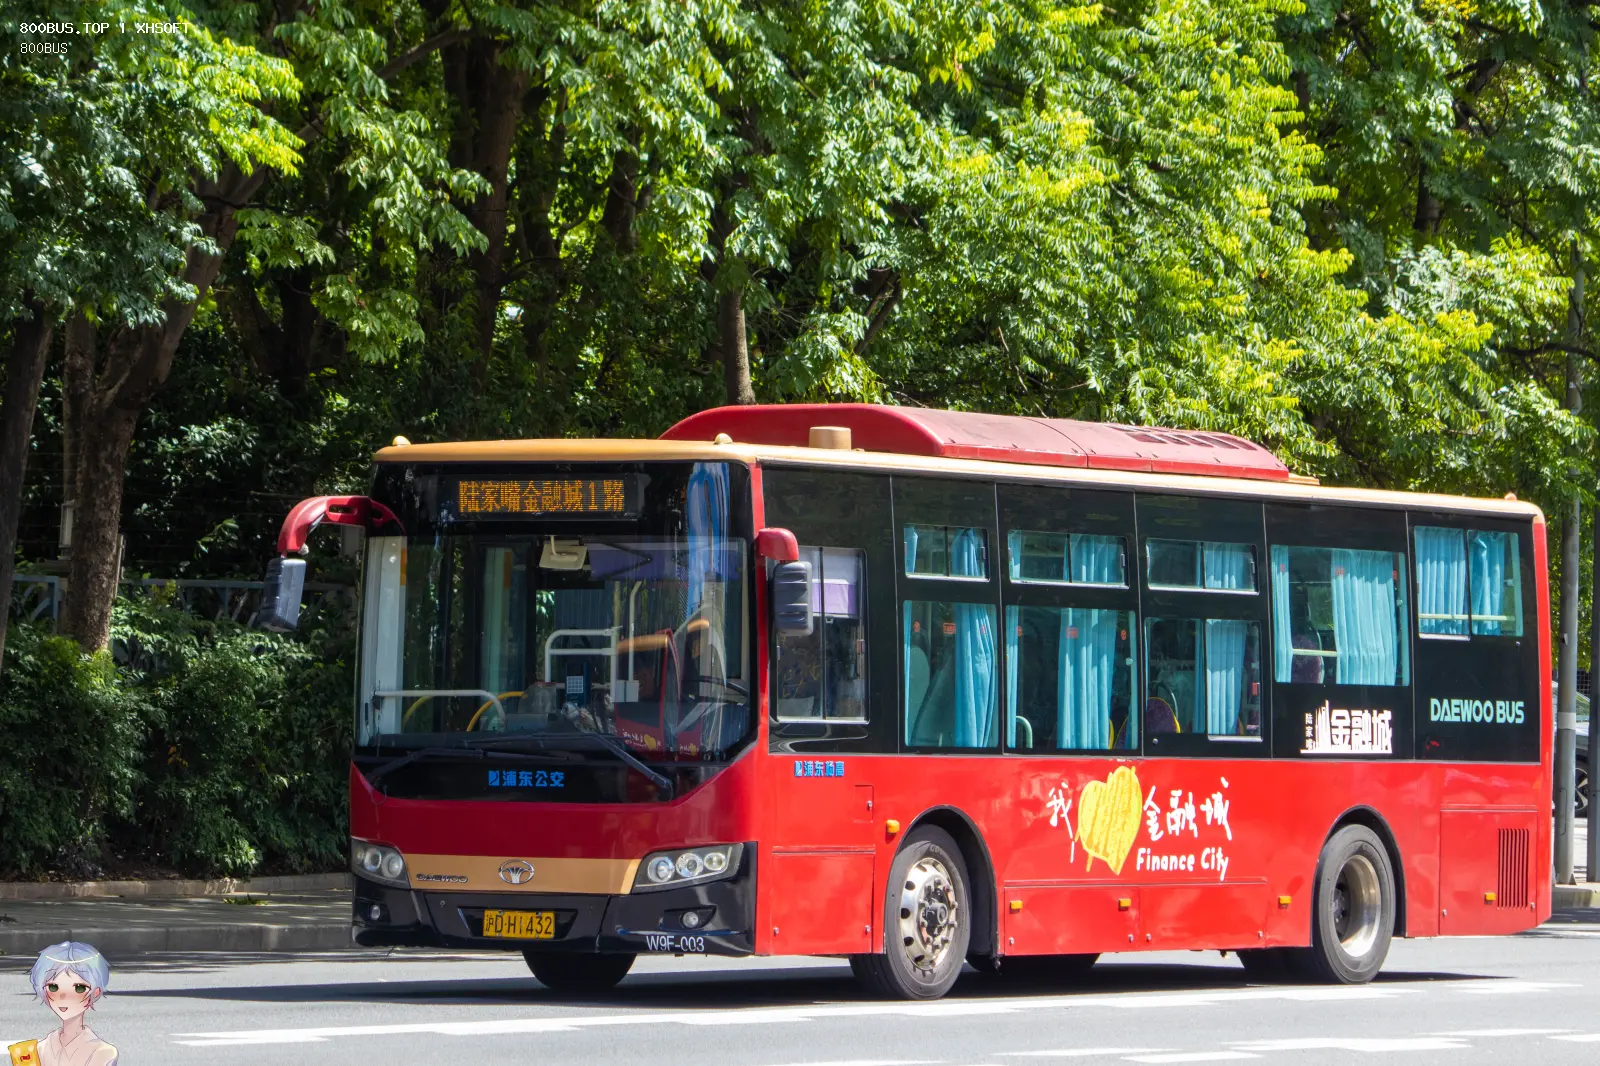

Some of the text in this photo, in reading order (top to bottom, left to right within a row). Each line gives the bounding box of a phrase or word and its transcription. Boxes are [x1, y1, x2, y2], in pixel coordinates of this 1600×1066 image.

[1430, 698, 1524, 724] DAEWOO BUS
[1330, 709, 1392, 751] 金融城
[503, 770, 565, 787] 浦东公交
[1046, 776, 1232, 863] 我 金融城
[1136, 847, 1229, 882] Finance City
[416, 873, 468, 883] DAEWOO
[645, 935, 705, 952] W9F-003
